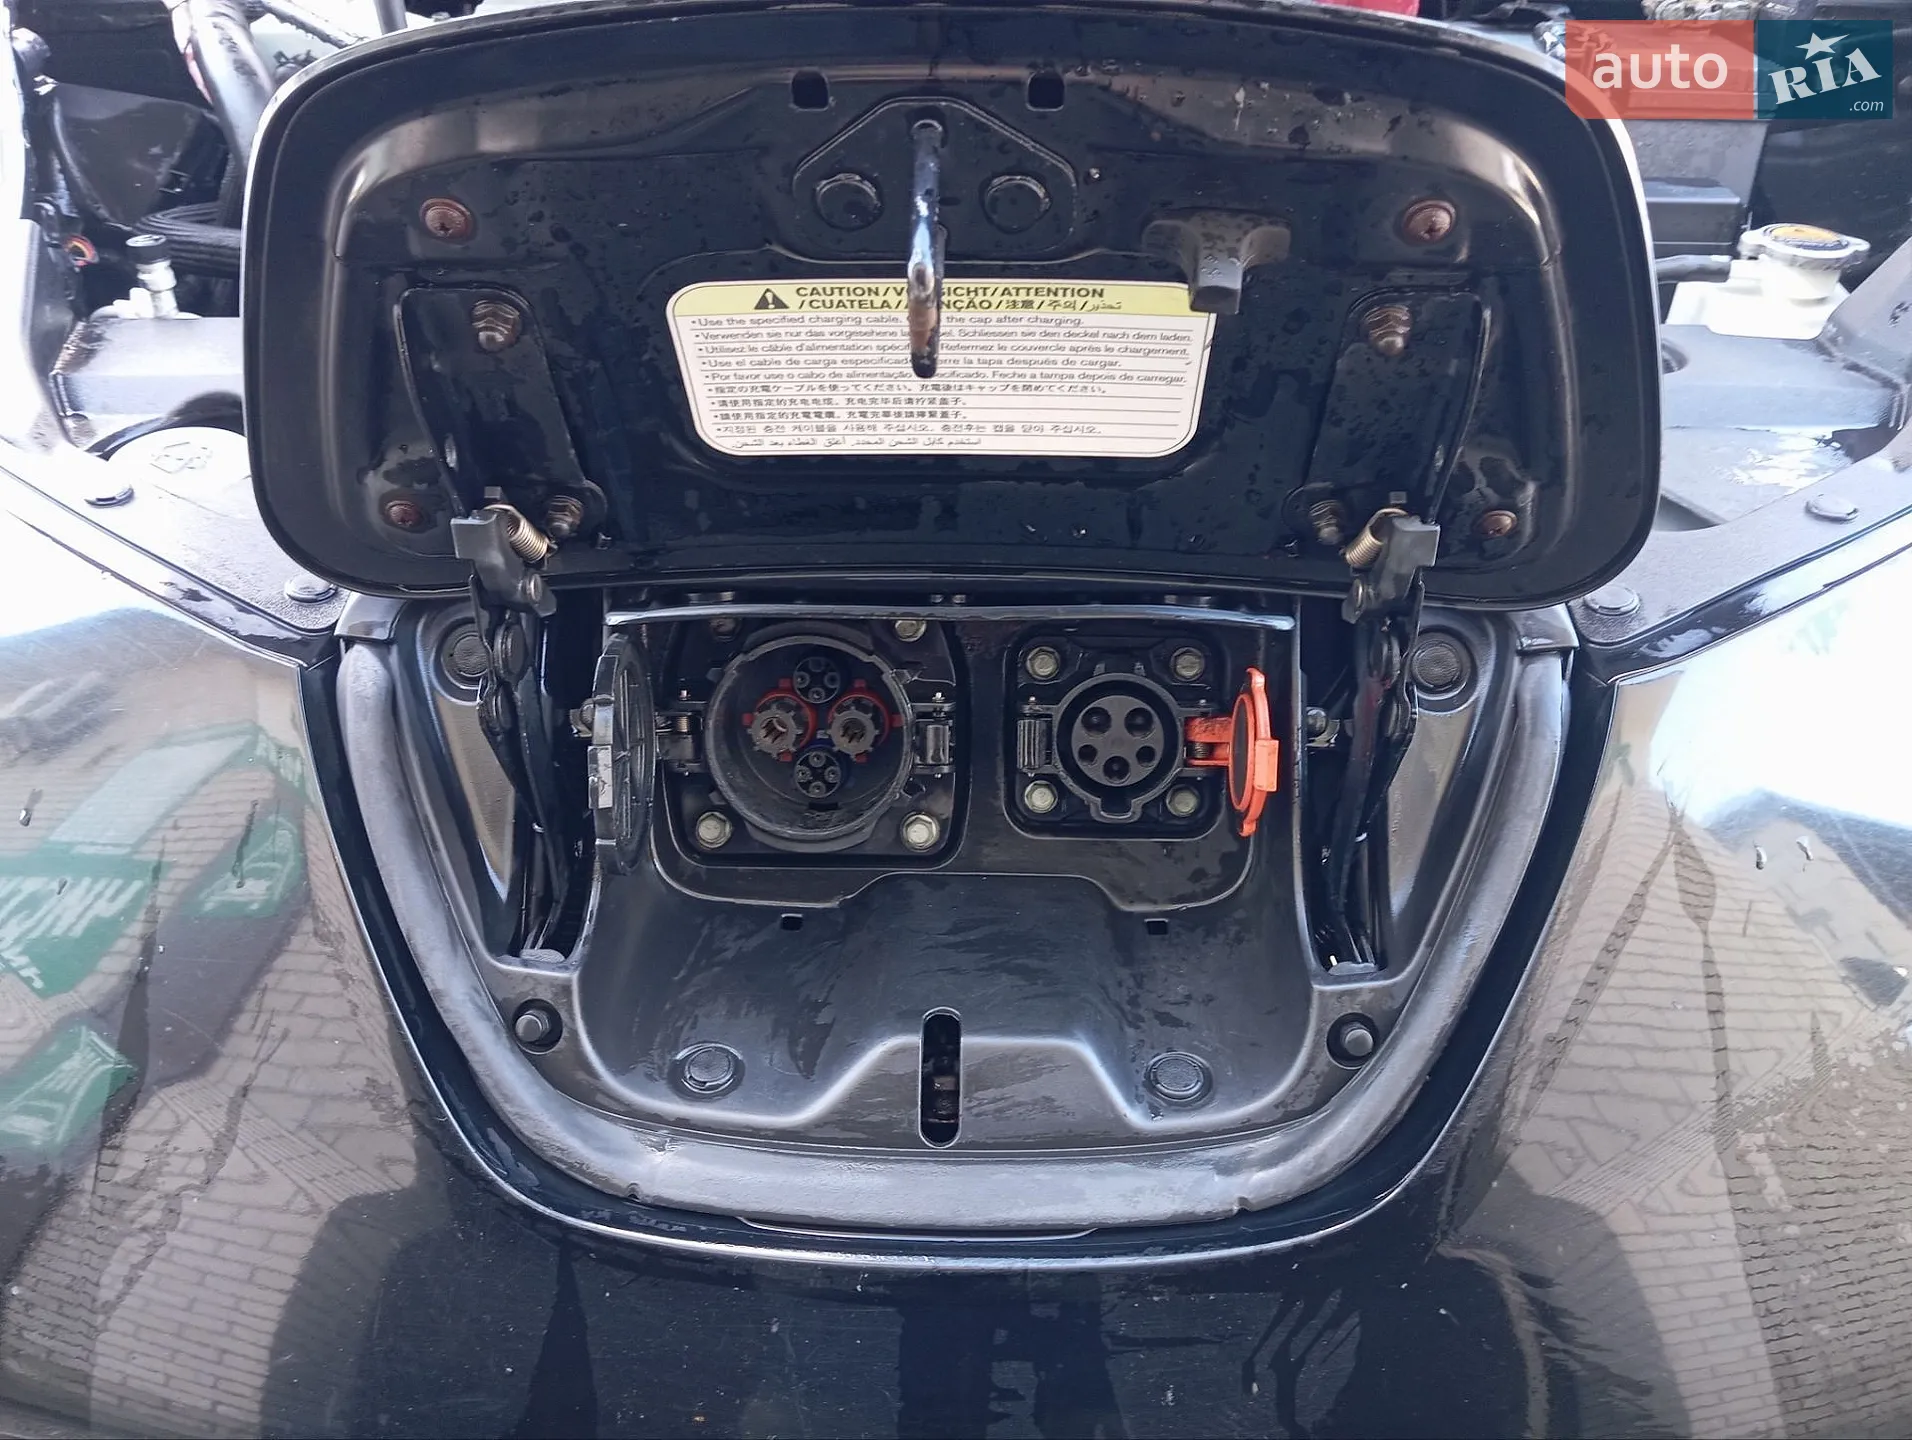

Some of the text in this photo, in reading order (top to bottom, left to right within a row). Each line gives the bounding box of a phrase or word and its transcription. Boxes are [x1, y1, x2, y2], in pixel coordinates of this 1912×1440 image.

[697, 318, 723, 326] Use
[726, 317, 745, 325] the
[749, 315, 805, 326] specified
[808, 314, 862, 326] charging
[946, 315, 965, 324] the
[968, 316, 992, 325] cap
[996, 315, 1024, 323] after
[766, 330, 782, 338] sie
[805, 329, 825, 338] das
[748, 345, 758, 353] le
[997, 343, 1008, 351] le
[1104, 344, 1115, 353] le
[708, 360, 732, 368] Use
[735, 359, 746, 367] el
[749, 358, 782, 367] cable
[785, 358, 799, 366] de
[804, 358, 837, 368] carga
[963, 357, 974, 365] la
[977, 358, 1003, 367] tapa
[1061, 358, 1077, 366] de
[711, 372, 731, 381] Por
[828, 371, 843, 379] de
[1118, 372, 1134, 381] de
